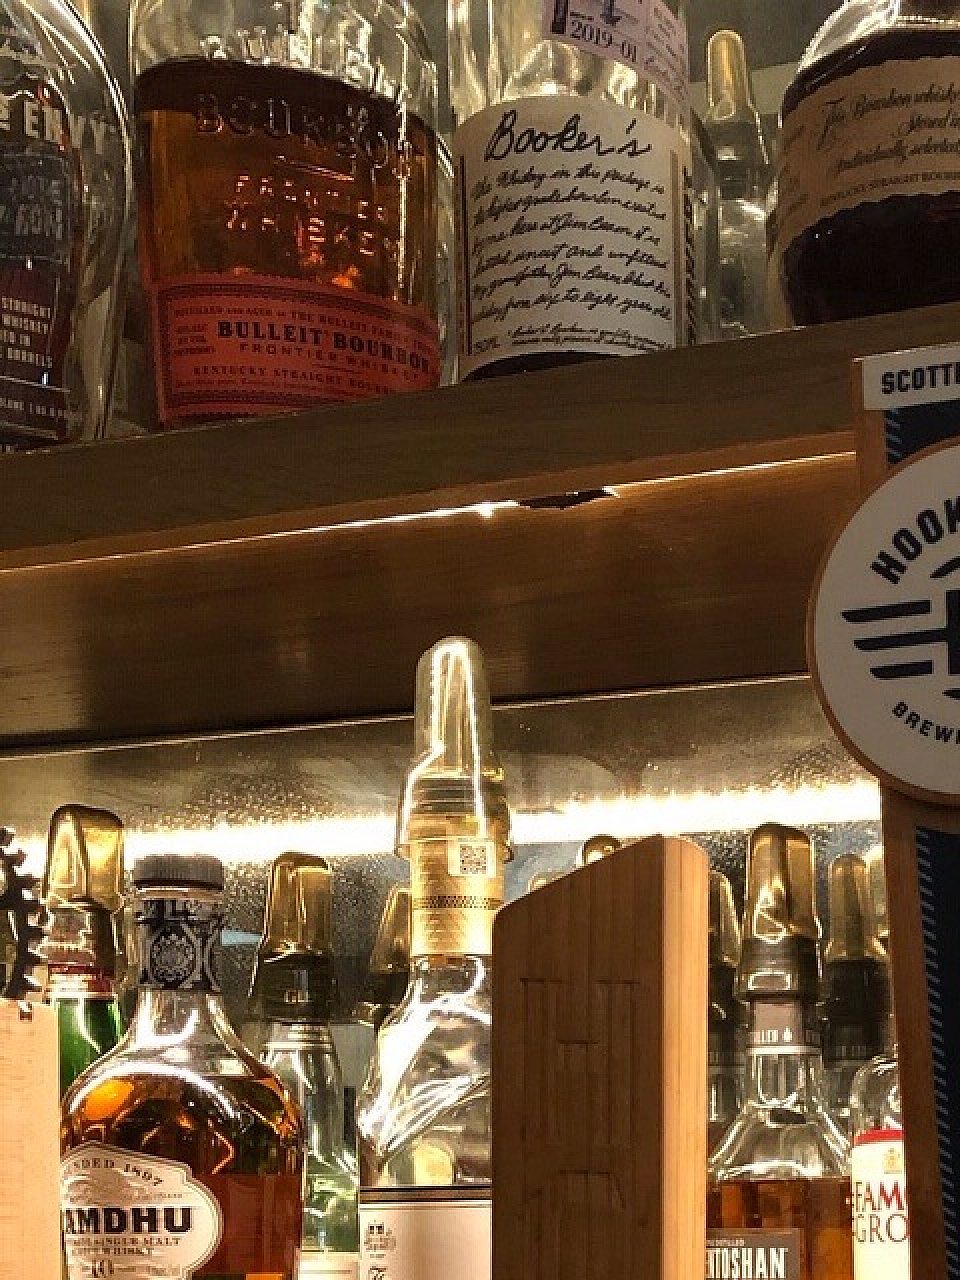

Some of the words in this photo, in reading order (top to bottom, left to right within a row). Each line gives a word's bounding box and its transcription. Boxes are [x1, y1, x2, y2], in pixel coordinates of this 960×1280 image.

[484, 109, 652, 162] Booker's
[217, 320, 323, 346] BULLEIT
[333, 331, 430, 373] BOURBON
[240, 342, 338, 362] FRONTIER
